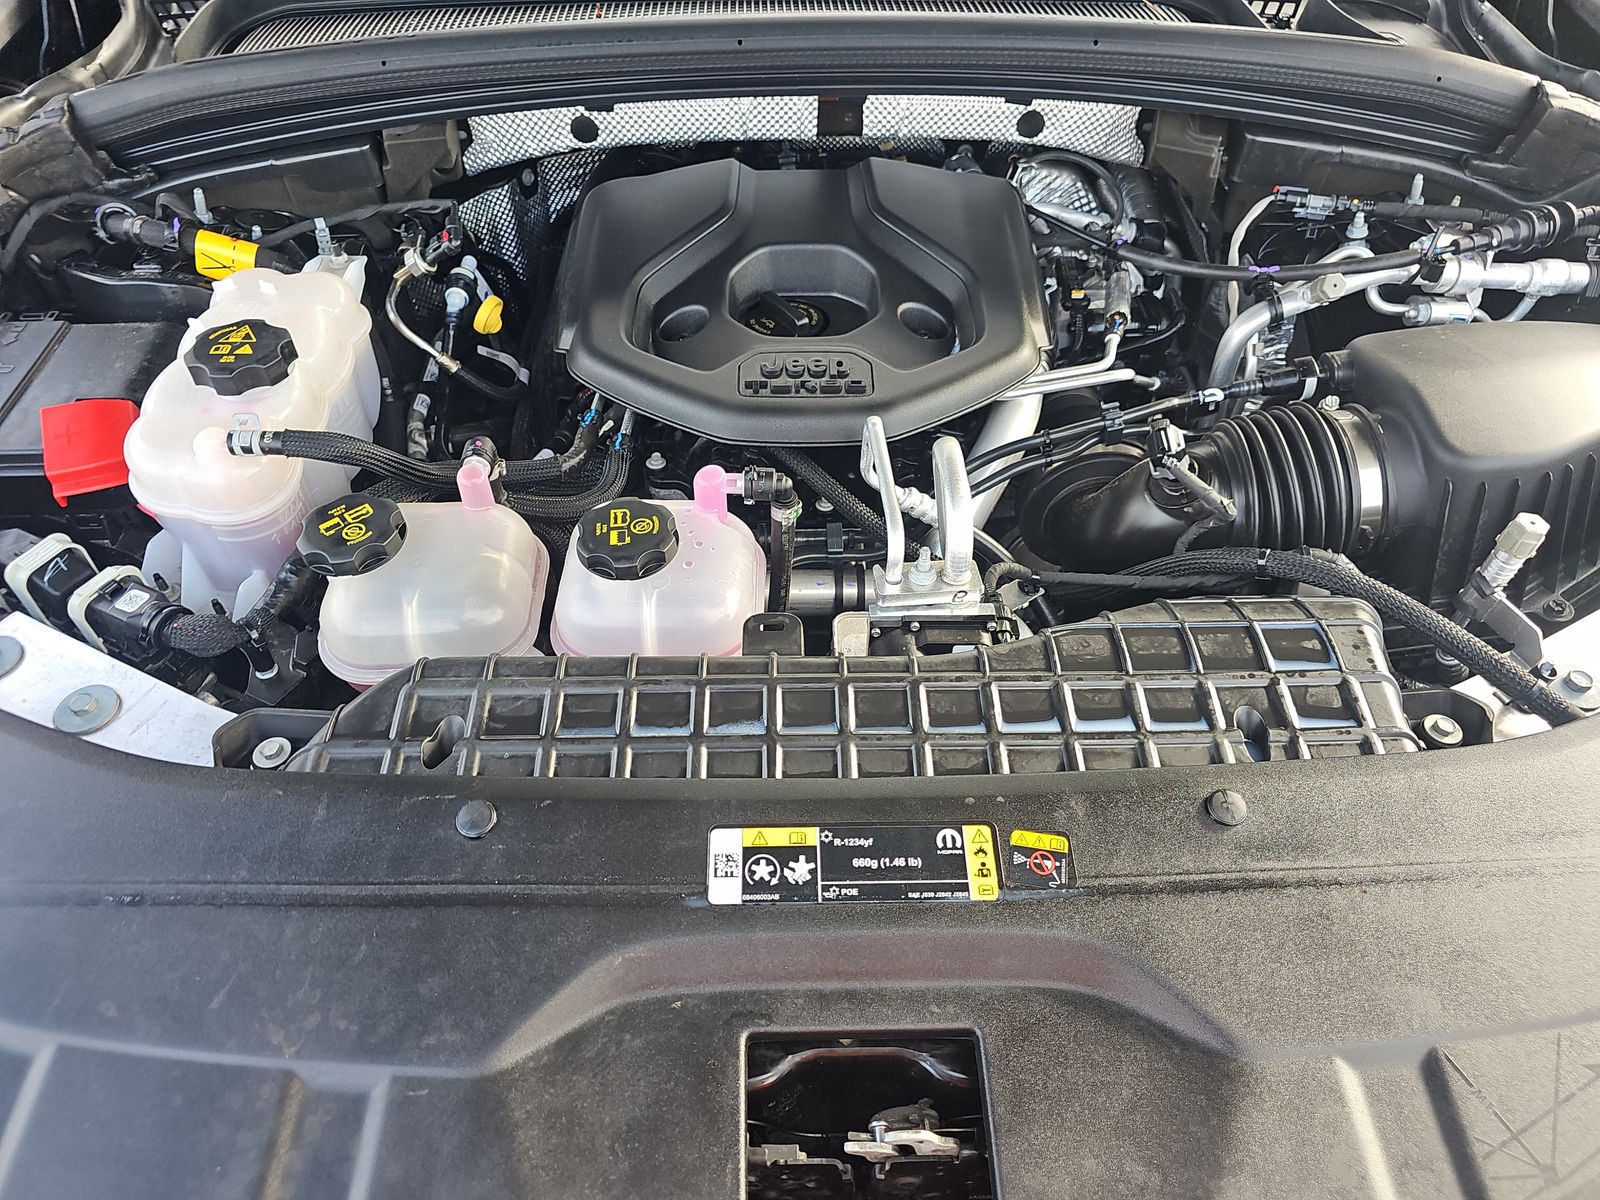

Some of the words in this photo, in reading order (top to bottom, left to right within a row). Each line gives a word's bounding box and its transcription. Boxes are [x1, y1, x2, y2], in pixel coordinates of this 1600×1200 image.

[760, 353, 850, 379] Jeep
[833, 838, 873, 848] R-1234yf
[852, 857, 878, 869] 660g
[880, 857, 906, 869] (1.46
[908, 856, 922, 869] lb)
[841, 888, 858, 896] POE
